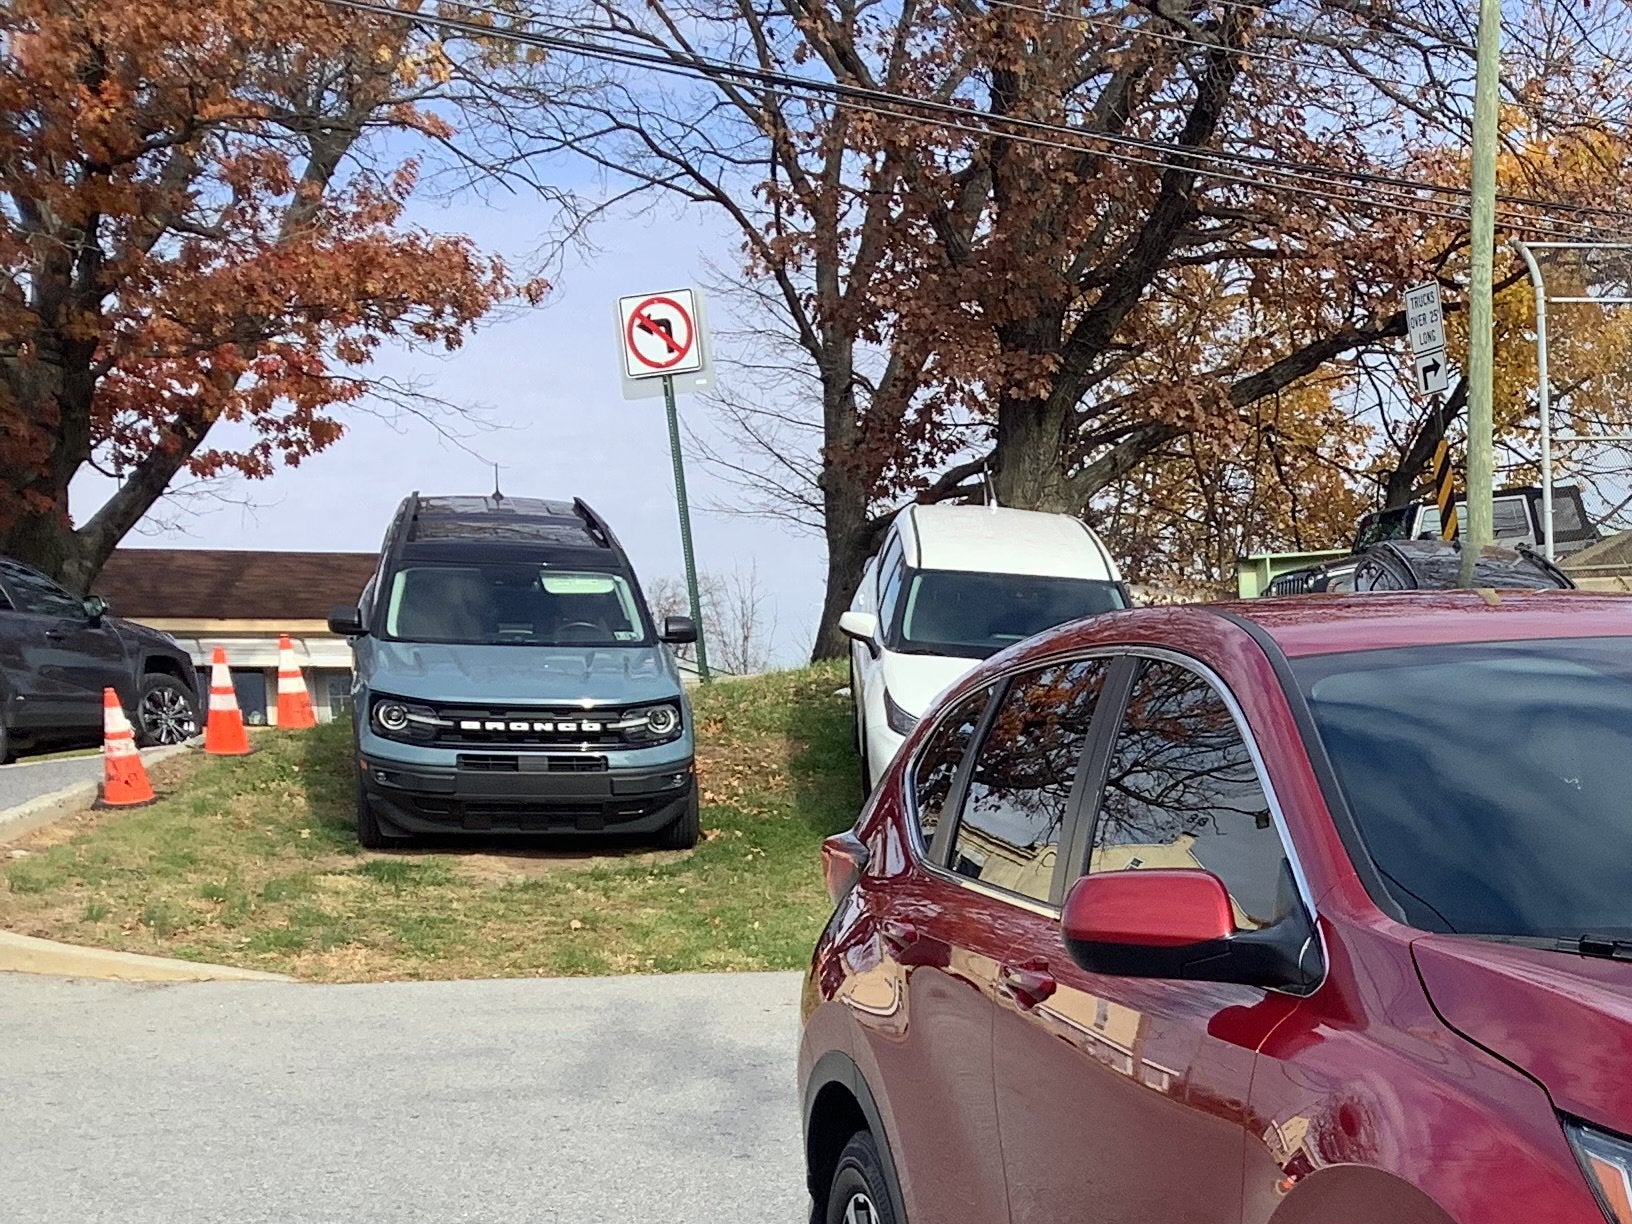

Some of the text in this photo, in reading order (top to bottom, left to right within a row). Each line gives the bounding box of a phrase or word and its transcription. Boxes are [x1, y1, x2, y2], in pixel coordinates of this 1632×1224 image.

[1410, 291, 1435, 310] TRUCKS
[1410, 313, 1427, 329] OVER
[1419, 330, 1436, 345] LONG
[460, 721, 601, 731] BRONCO
